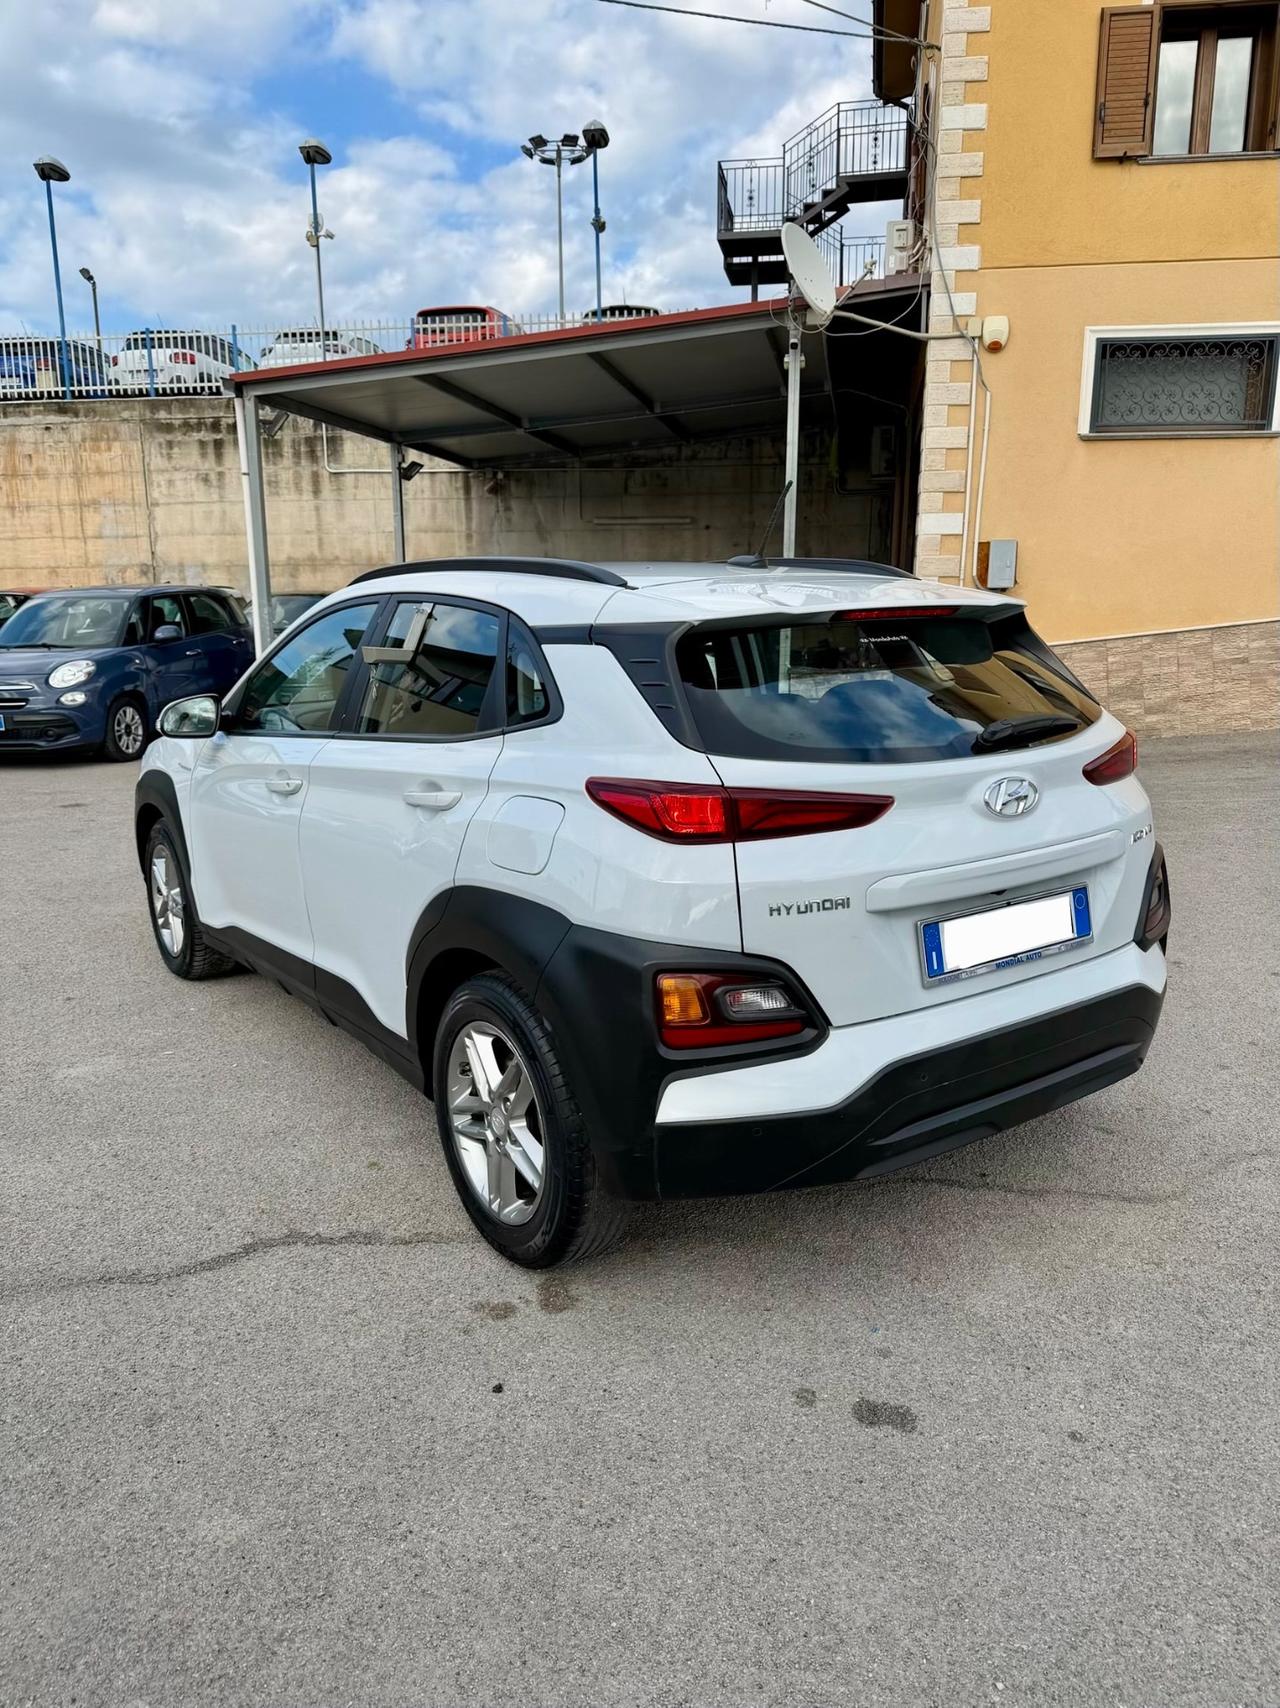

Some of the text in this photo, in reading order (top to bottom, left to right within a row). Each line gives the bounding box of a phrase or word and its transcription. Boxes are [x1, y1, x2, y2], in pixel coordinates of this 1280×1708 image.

[768, 896, 851, 917] HYUNDAI
[995, 951, 1042, 969] MONDIAL AUTO
